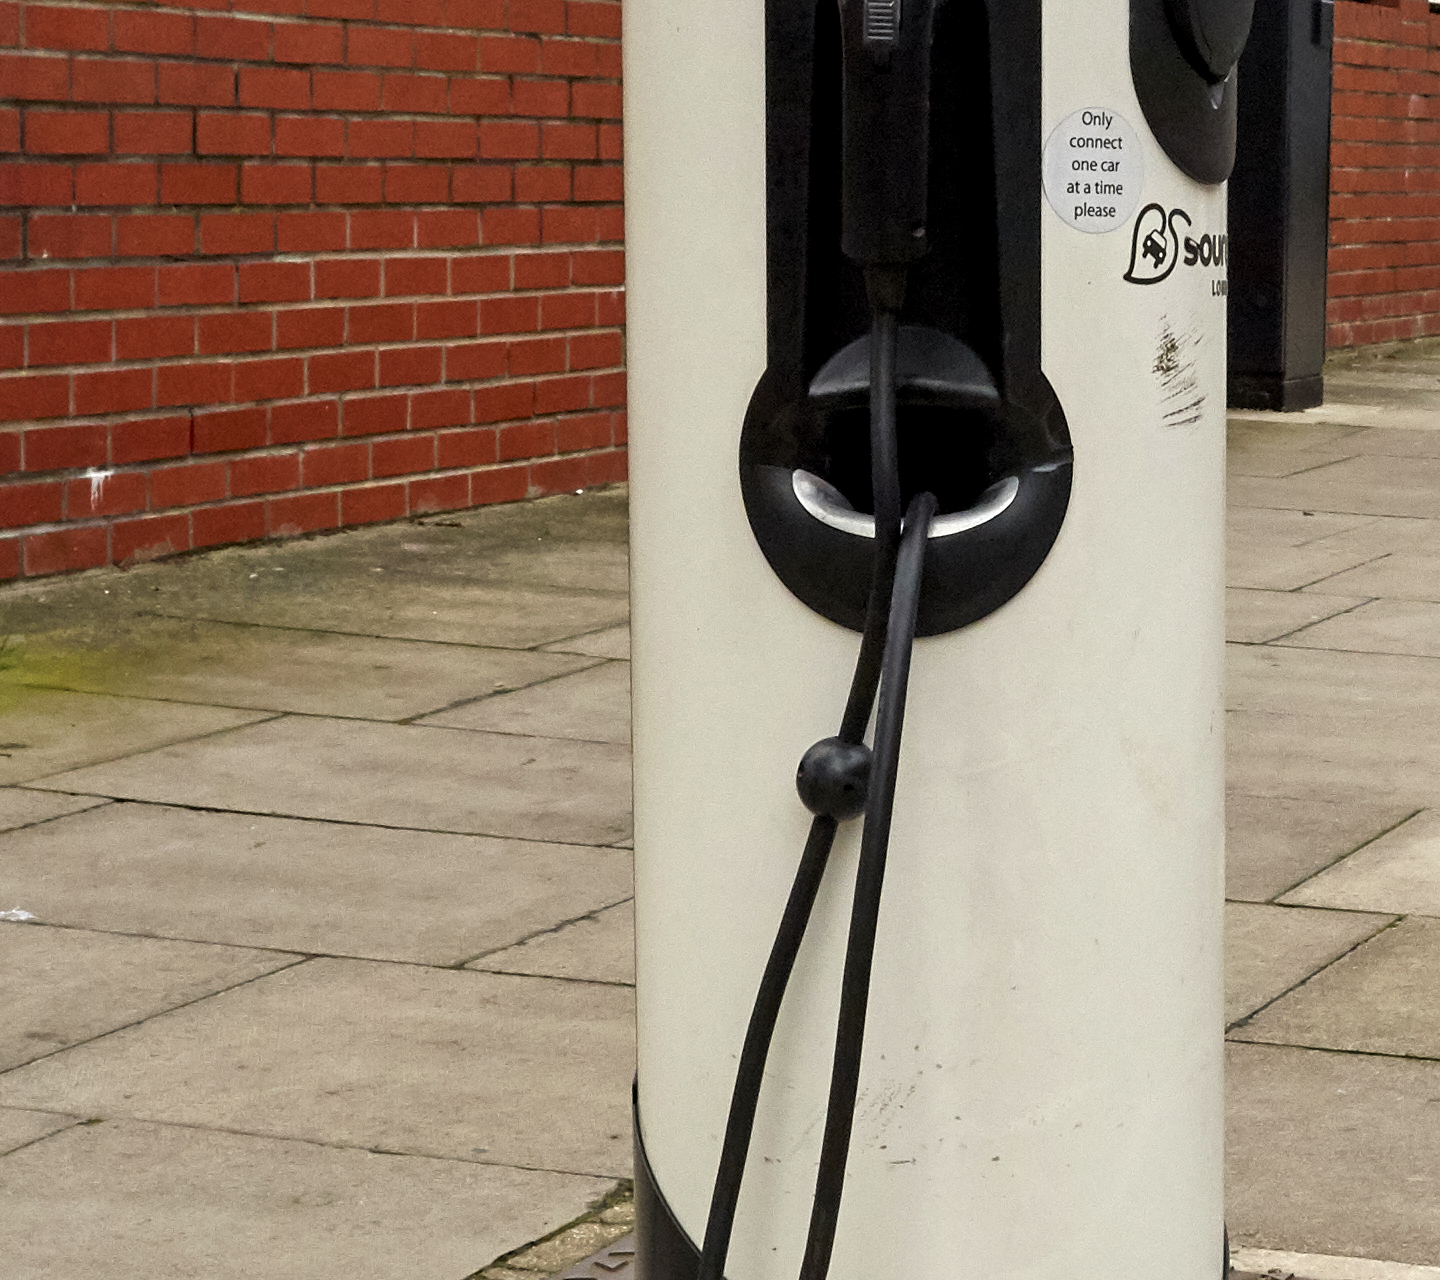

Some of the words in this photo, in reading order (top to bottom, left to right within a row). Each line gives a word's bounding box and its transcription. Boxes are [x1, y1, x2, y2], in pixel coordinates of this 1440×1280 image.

[1081, 111, 1113, 130] Only
[1069, 136, 1123, 150] connect
[1071, 159, 1098, 171] one
[1100, 160, 1120, 172] car
[1066, 181, 1080, 194] at
[1083, 184, 1091, 194] a
[1094, 180, 1124, 195] time
[1074, 202, 1116, 220] please
